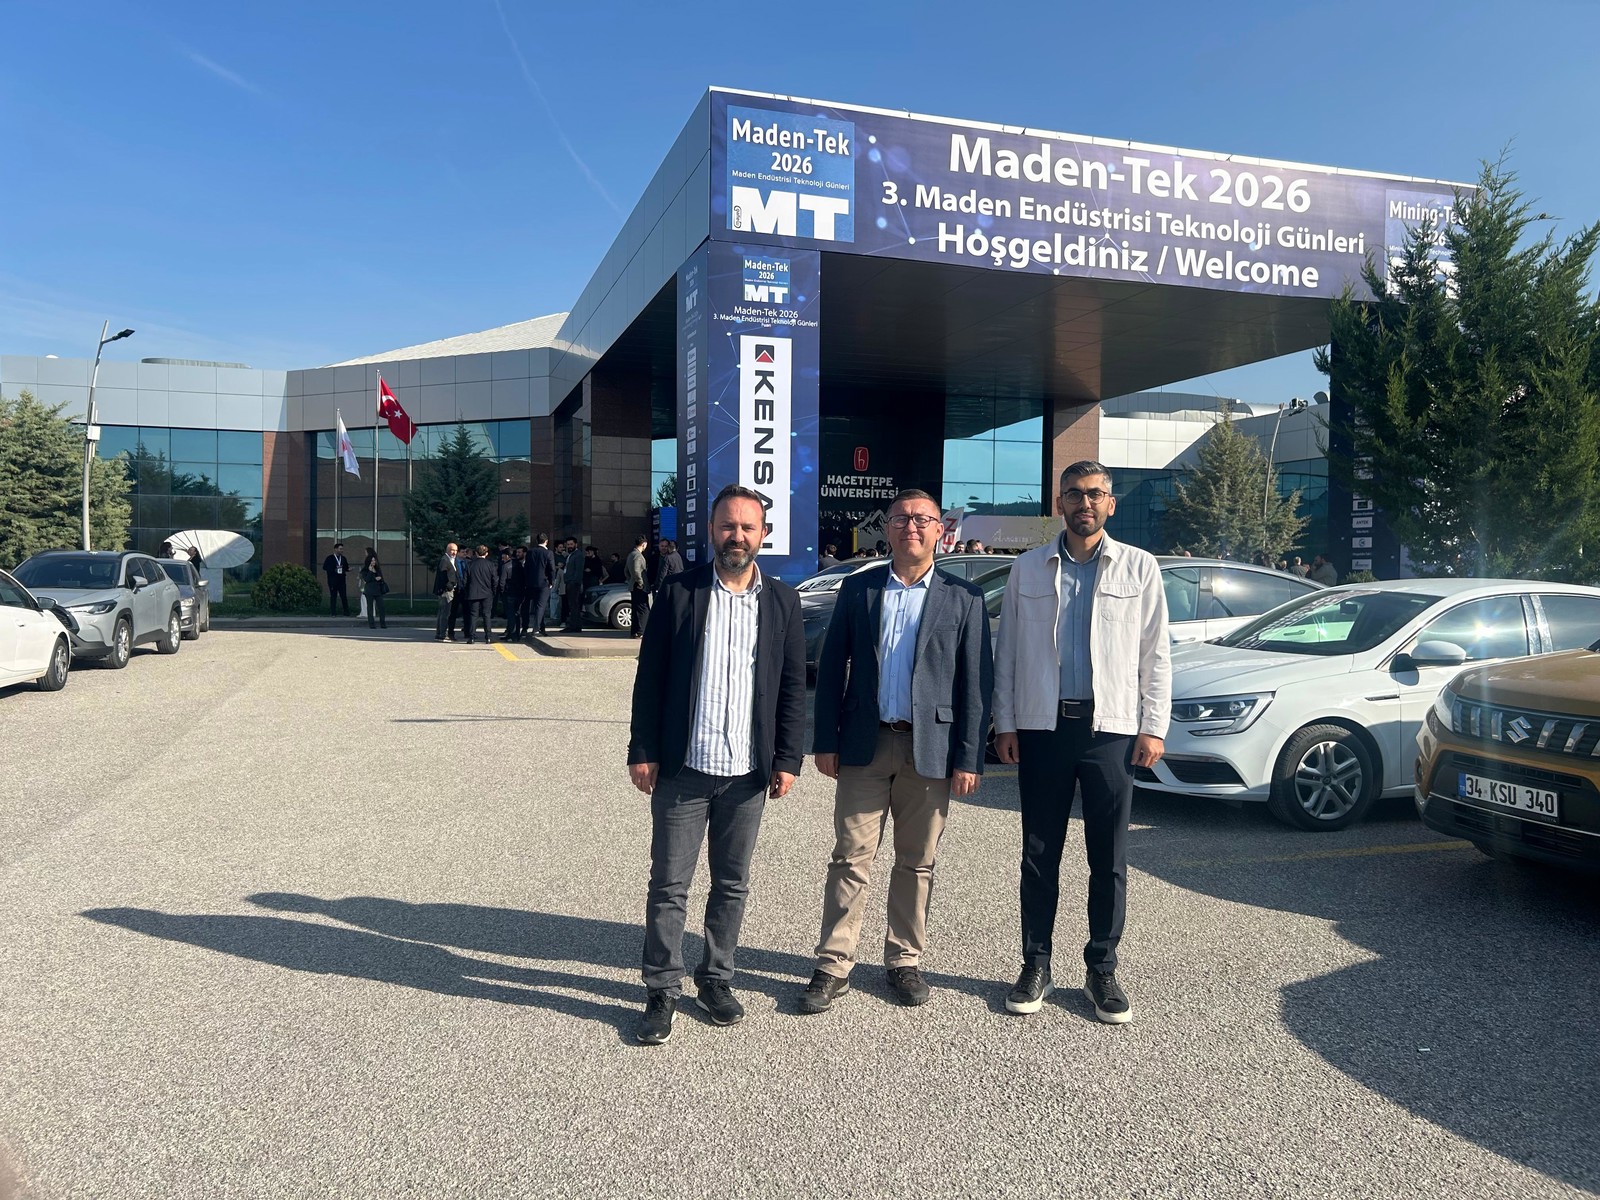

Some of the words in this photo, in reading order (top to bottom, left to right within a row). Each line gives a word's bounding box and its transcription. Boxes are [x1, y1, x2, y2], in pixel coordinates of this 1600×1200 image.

[732, 118, 850, 155] Maden-Tek
[771, 152, 813, 175] 2026
[950, 133, 1199, 201] Maden-Tek
[1209, 168, 1311, 213] 2026
[732, 170, 756, 179] Maden
[758, 172, 792, 183] Endüstrisi
[793, 177, 824, 188] Teknoloji
[825, 181, 850, 190] Günleri
[732, 185, 850, 240] MT
[882, 181, 907, 206] 3.
[915, 184, 1011, 217] Maden
[1019, 196, 1151, 233] Endüstrisi
[1156, 212, 1271, 250] Teknoloji
[1276, 226, 1365, 254] Günleri
[744, 259, 789, 272] Maden-Tek
[938, 222, 1149, 272] Hoşgeldiniz
[1156, 246, 1169, 275] /
[1174, 247, 1319, 288] Welcome
[758, 271, 775, 280] 2026
[744, 283, 789, 304] MT
[719, 313, 741, 322] Maden
[741, 315, 770, 324] Endüstrisi
[770, 317, 797, 327] Teknoloji
[797, 319, 818, 328] Günleri
[734, 305, 778, 317] Maden-Tek
[779, 309, 799, 319] 2026
[827, 474, 894, 487] HACETTEPE
[820, 484, 899, 499] ÜNİVERSİTESİ
[1466, 777, 1482, 798] 34
[1490, 781, 1517, 806] KSU
[1525, 790, 1555, 814] 340
